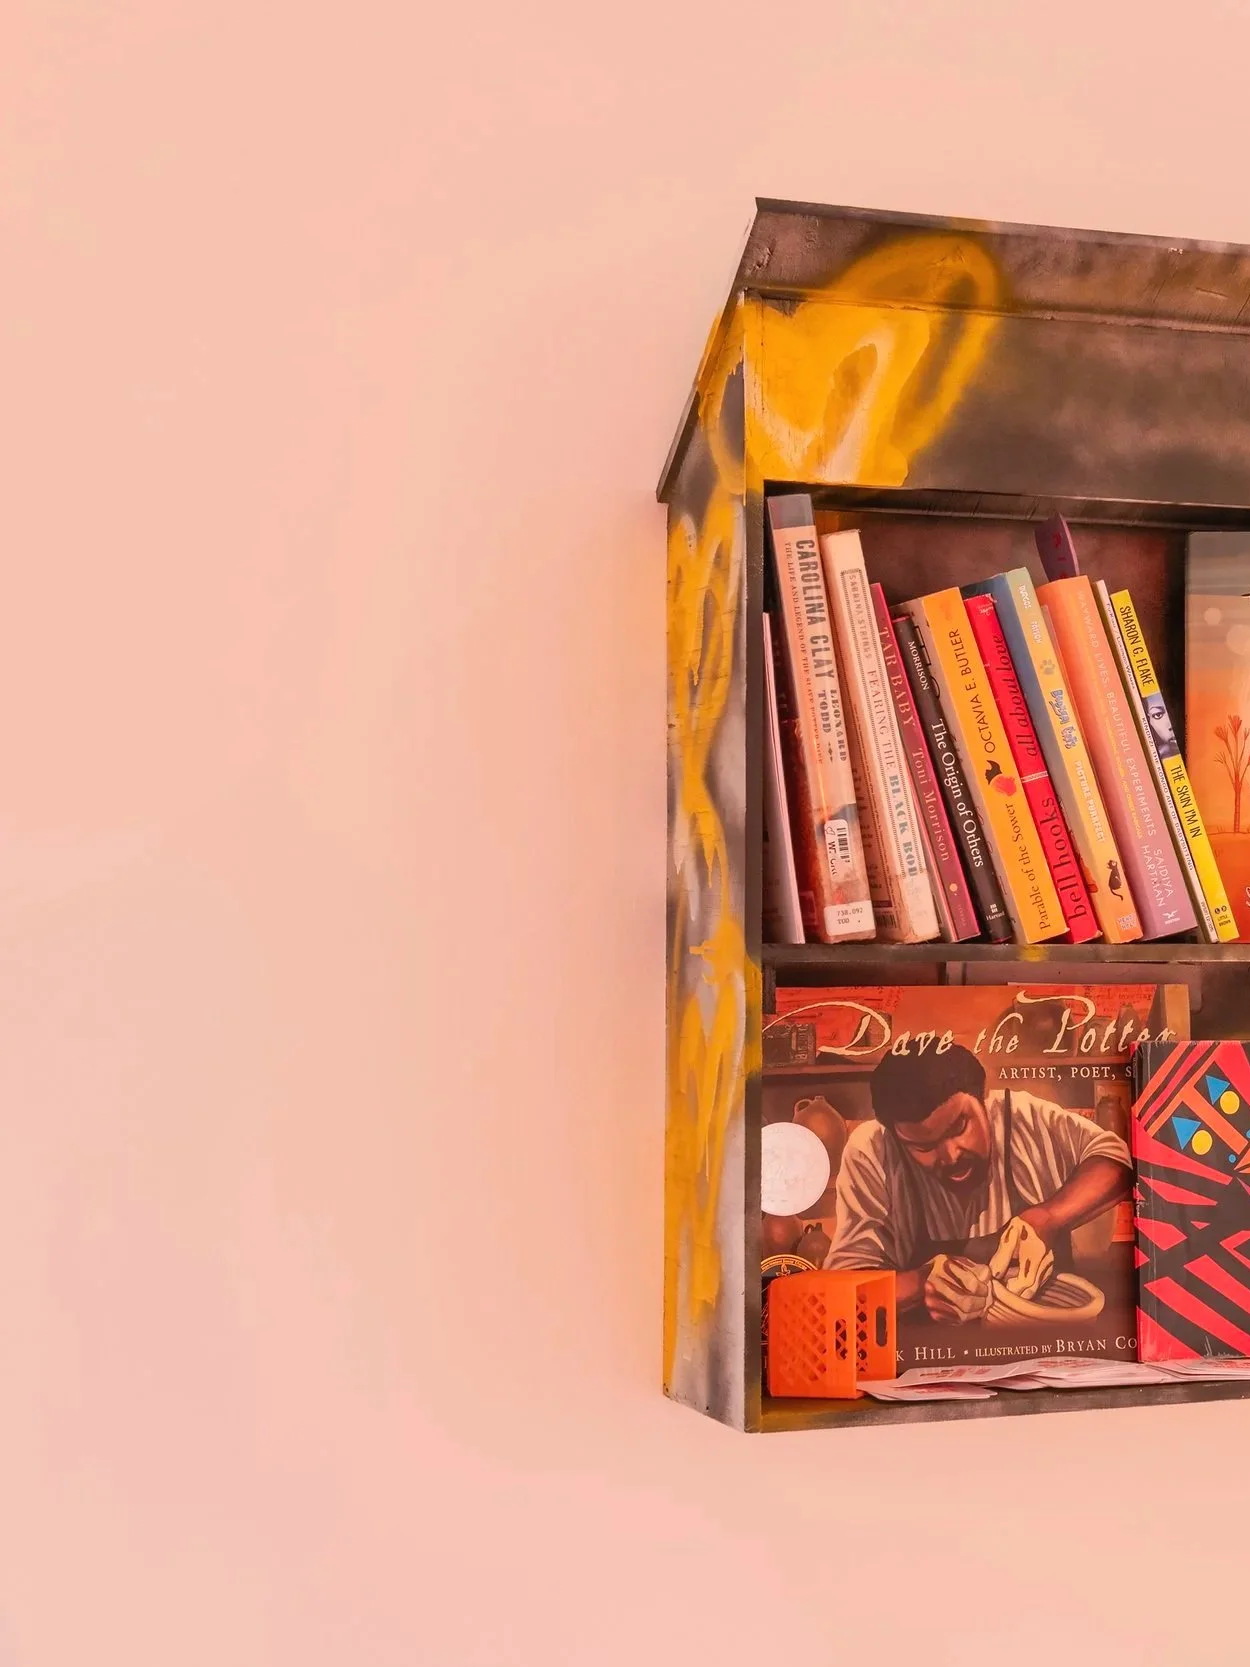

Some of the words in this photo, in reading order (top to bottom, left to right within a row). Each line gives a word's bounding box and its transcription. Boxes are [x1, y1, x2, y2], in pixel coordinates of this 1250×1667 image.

[785, 541, 793, 560] THE
[787, 562, 796, 582] LIFE
[796, 540, 826, 625] CAROLINA
[791, 585, 799, 602] AND
[849, 575, 863, 616] SABRINA
[793, 606, 805, 641] LEGEND
[1119, 605, 1139, 646] SHARON
[810, 635, 834, 679] CLAY
[908, 640, 930, 691] MORRISON
[949, 629, 972, 676] BUTLER
[993, 635, 1012, 672] love
[1132, 646, 1144, 658] G.
[965, 678, 977, 691] E.
[1136, 657, 1155, 687] FLAKE
[818, 690, 832, 733] TODD
[868, 670, 889, 735] FEARING
[1001, 678, 1029, 728] about
[931, 718, 948, 750] The
[970, 693, 996, 754] OCTAVIA
[879, 626, 898, 666] TAR
[890, 674, 916, 728] BABY
[912, 748, 928, 785] Toni
[923, 791, 951, 862] Morrison
[882, 739, 897, 770] THE
[1016, 734, 1037, 757] all
[1077, 591, 1099, 648] WAYWARD
[1105, 691, 1131, 753] BEAUTIFUL
[1125, 758, 1157, 837] EXPERIMENTS
[1153, 849, 1174, 898] SAIDIYA
[942, 752, 963, 798] Origin
[1074, 760, 1092, 798] PICTURE
[1170, 764, 1186, 784] THE
[888, 775, 909, 836] BLACK
[956, 802, 973, 817] of
[1176, 785, 1193, 810] SKIN
[1005, 803, 1024, 843] Sower
[1039, 797, 1072, 870] hooks
[1184, 809, 1198, 826] I'M
[1190, 826, 1203, 839] IN
[963, 819, 983, 868] Others
[1017, 846, 1032, 866] the
[1021, 868, 1036, 882] of
[1141, 845, 1165, 907] HARTMAN
[1028, 885, 1051, 930] Parable
[1056, 875, 1088, 921] bell
[762, 1001, 955, 1057] Dave
[974, 1012, 1023, 1055] the
[1016, 989, 1177, 1053] Potter
[999, 1067, 1063, 1082] ARTIST,
[1071, 1066, 1117, 1081] POET,
[914, 1347, 956, 1361] HILL
[975, 1346, 1039, 1358] ILLUSTRATED
[1042, 1345, 1053, 1353] BY
[1055, 1338, 1107, 1353] BRYAN
